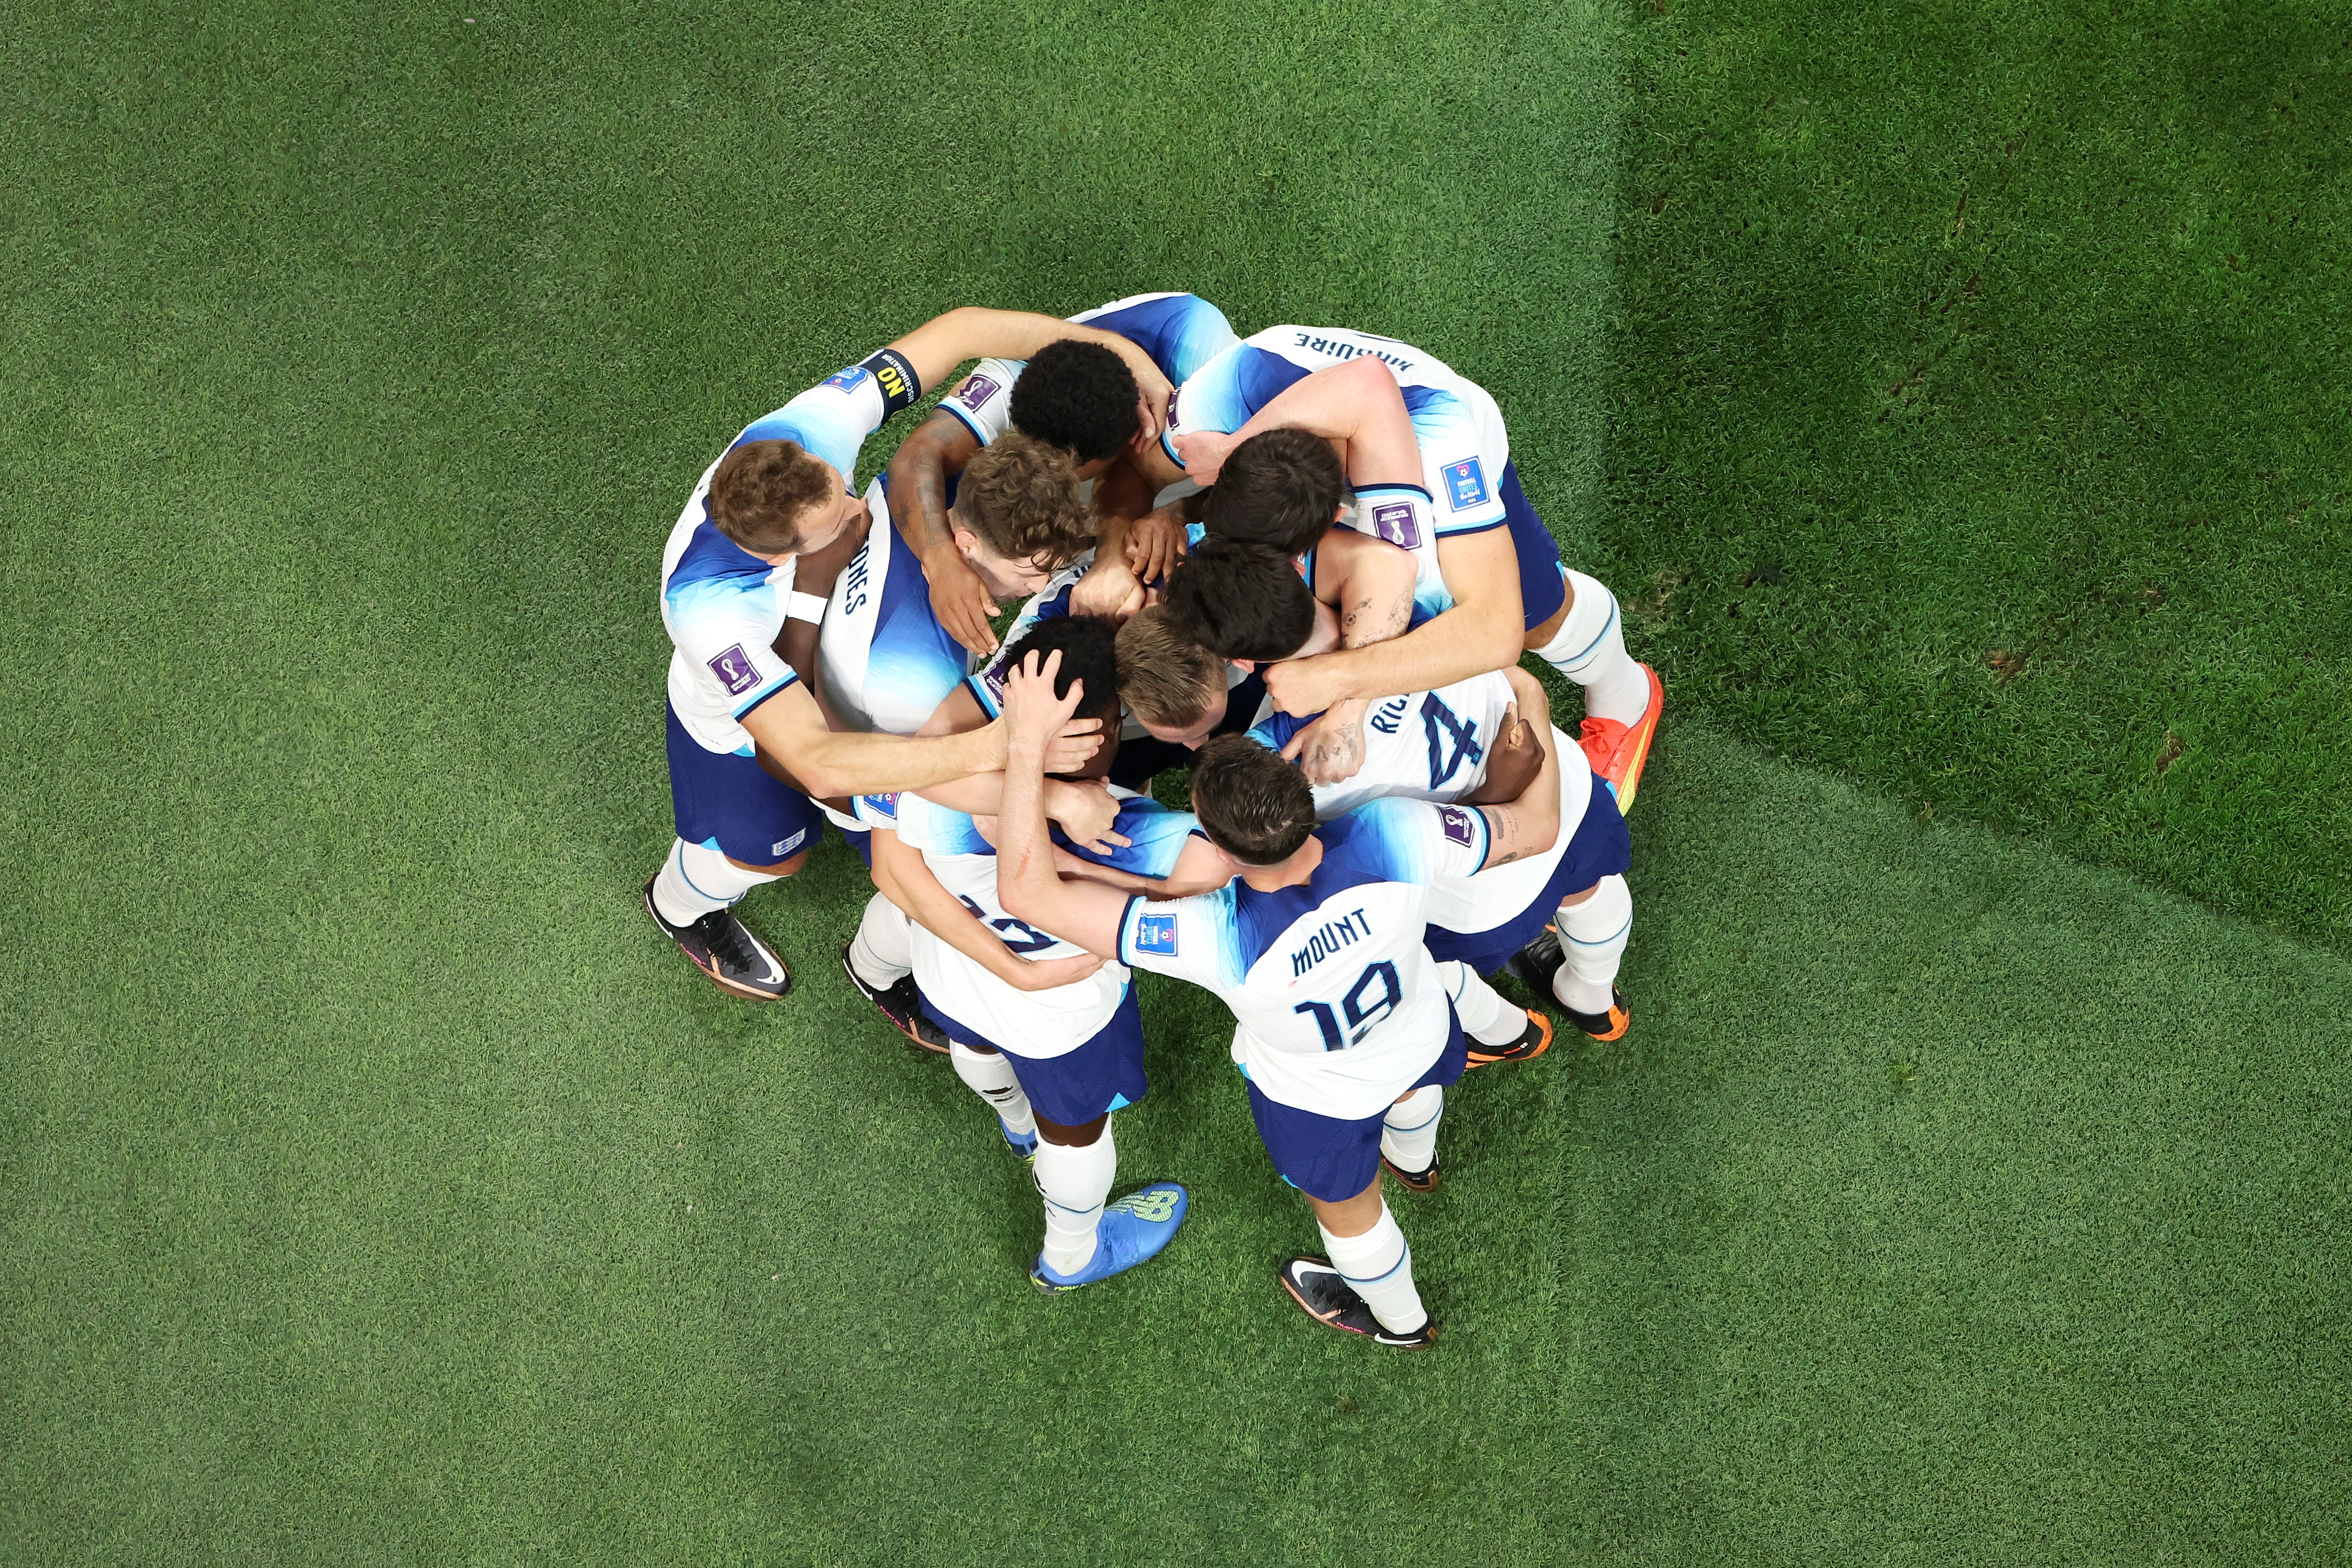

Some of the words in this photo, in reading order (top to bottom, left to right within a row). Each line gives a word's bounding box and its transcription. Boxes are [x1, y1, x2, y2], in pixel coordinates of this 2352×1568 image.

[877, 367, 905, 398] NO
[881, 353, 914, 403] DISCRIMINATION
[1458, 482, 1478, 493] UNITES
[845, 533, 869, 615] ONES
[1371, 693, 1410, 734] RIC
[1419, 690, 1483, 792] 4
[1291, 908, 1371, 977] MOUNT
[1292, 958, 1403, 1052] 19
